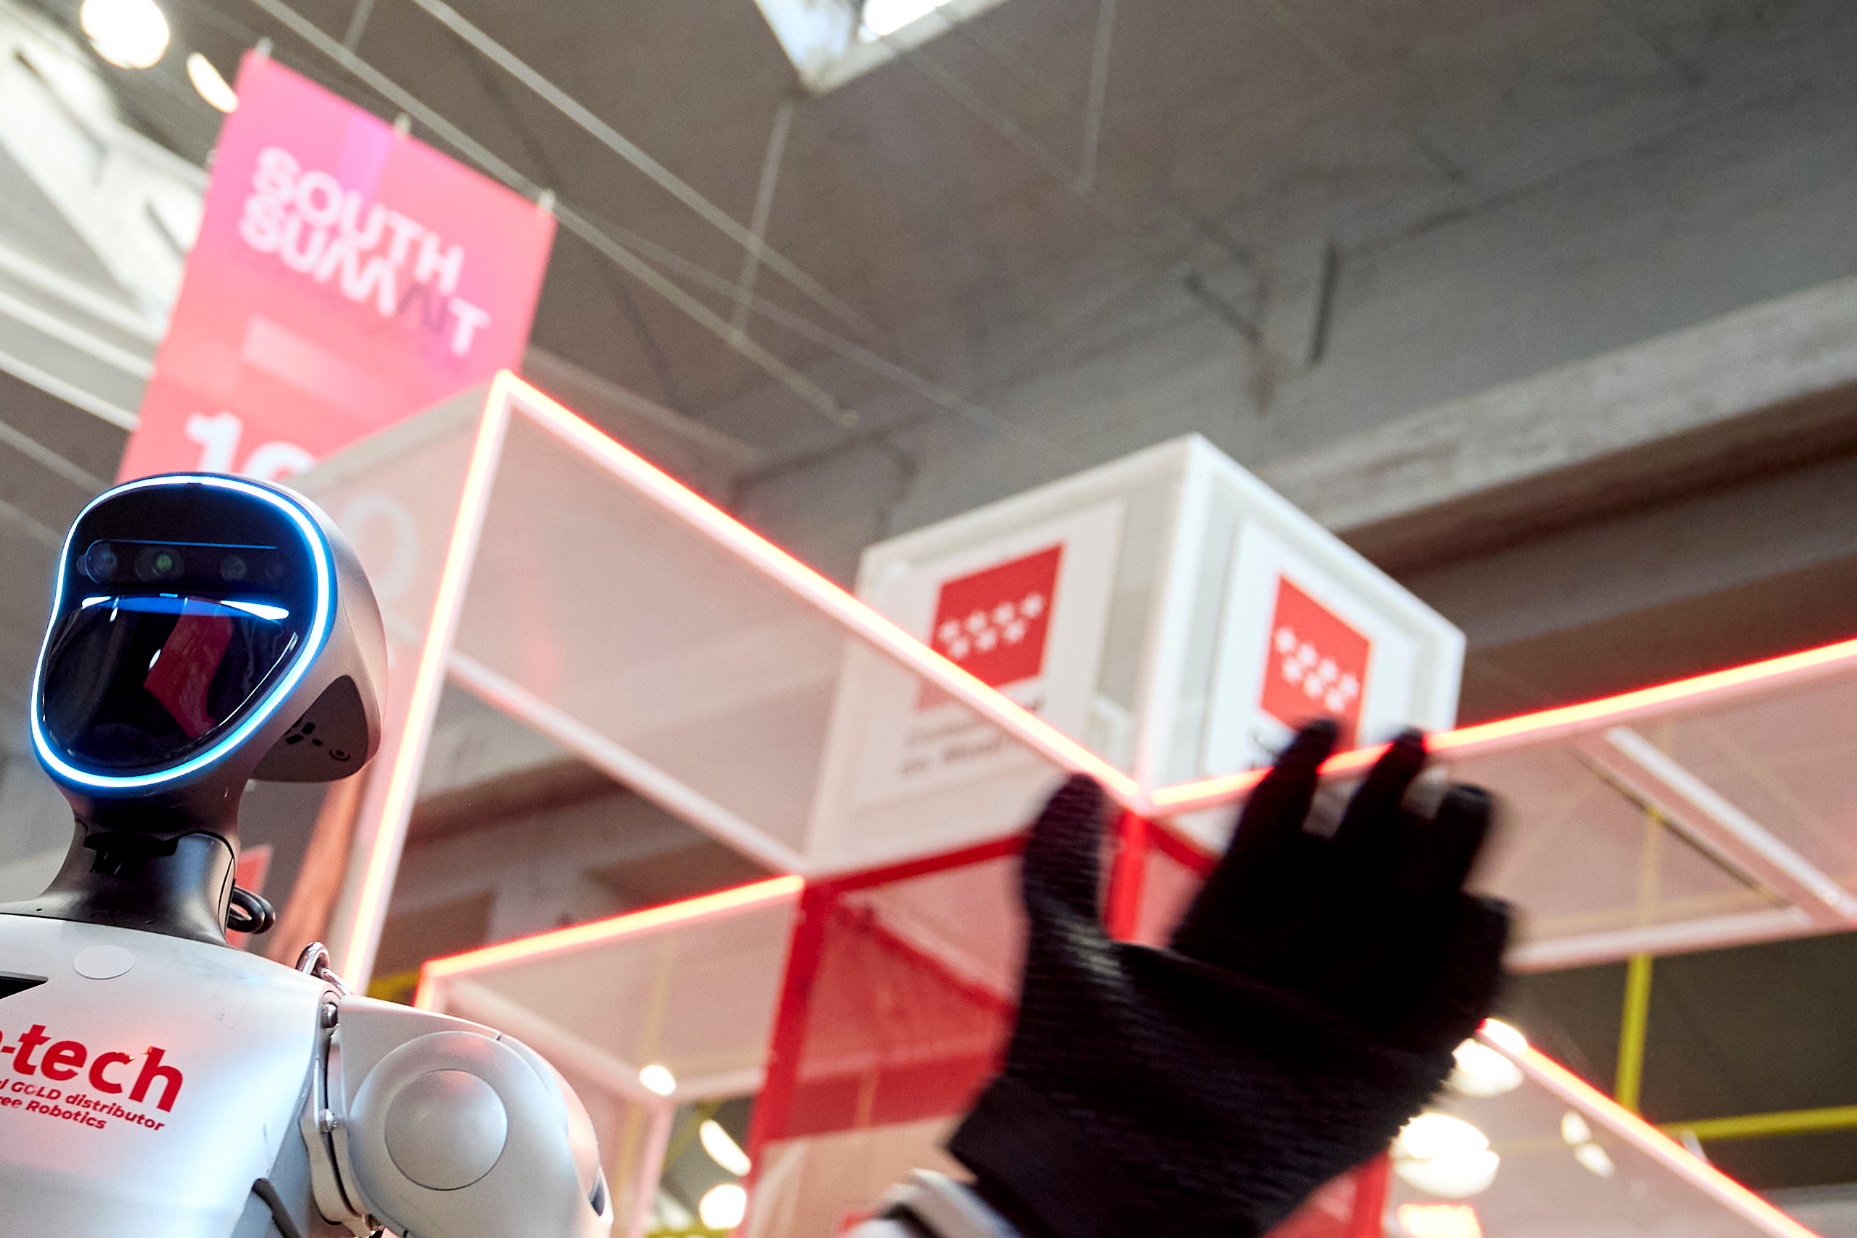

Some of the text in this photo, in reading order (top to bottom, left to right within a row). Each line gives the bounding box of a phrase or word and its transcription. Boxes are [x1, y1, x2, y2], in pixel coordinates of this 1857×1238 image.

[252, 146, 465, 296] SOUTH
[11, 1080, 62, 1102] GOLD
[65, 1092, 166, 1133] distributor
[26, 1099, 107, 1131] Robotics
